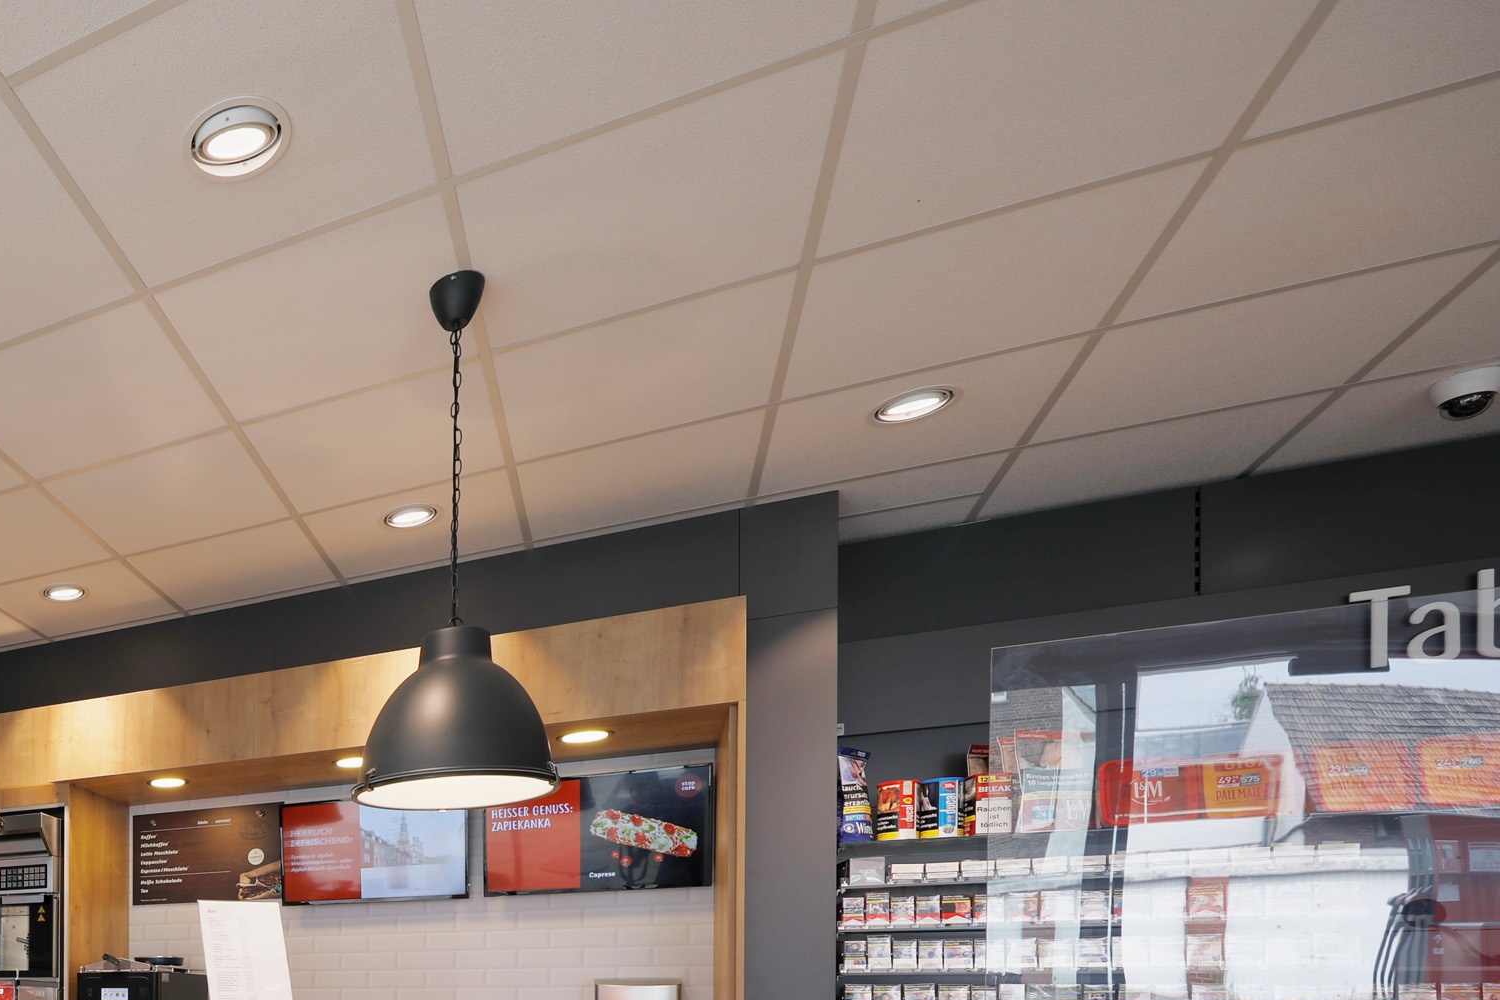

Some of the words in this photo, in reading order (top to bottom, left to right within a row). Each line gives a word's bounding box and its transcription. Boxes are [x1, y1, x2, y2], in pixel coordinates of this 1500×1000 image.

[1223, 756, 1268, 771] GIGA
[1240, 774, 1260, 784] 575
[681, 781, 696, 789] stop
[978, 784, 1012, 792] BREAK
[1134, 780, 1163, 799] L&M
[1216, 788, 1236, 801] PALL
[491, 805, 530, 819] HEISSER
[531, 803, 573, 817] GENUSS:
[977, 805, 1012, 813] Rauchen
[491, 818, 551, 832] ZAPIEKANKA
[980, 820, 1009, 828] tödlich
[290, 827, 332, 837] HERRLICH
[290, 836, 353, 847] ERFRISCHEND:
[588, 871, 616, 880] Caprese
